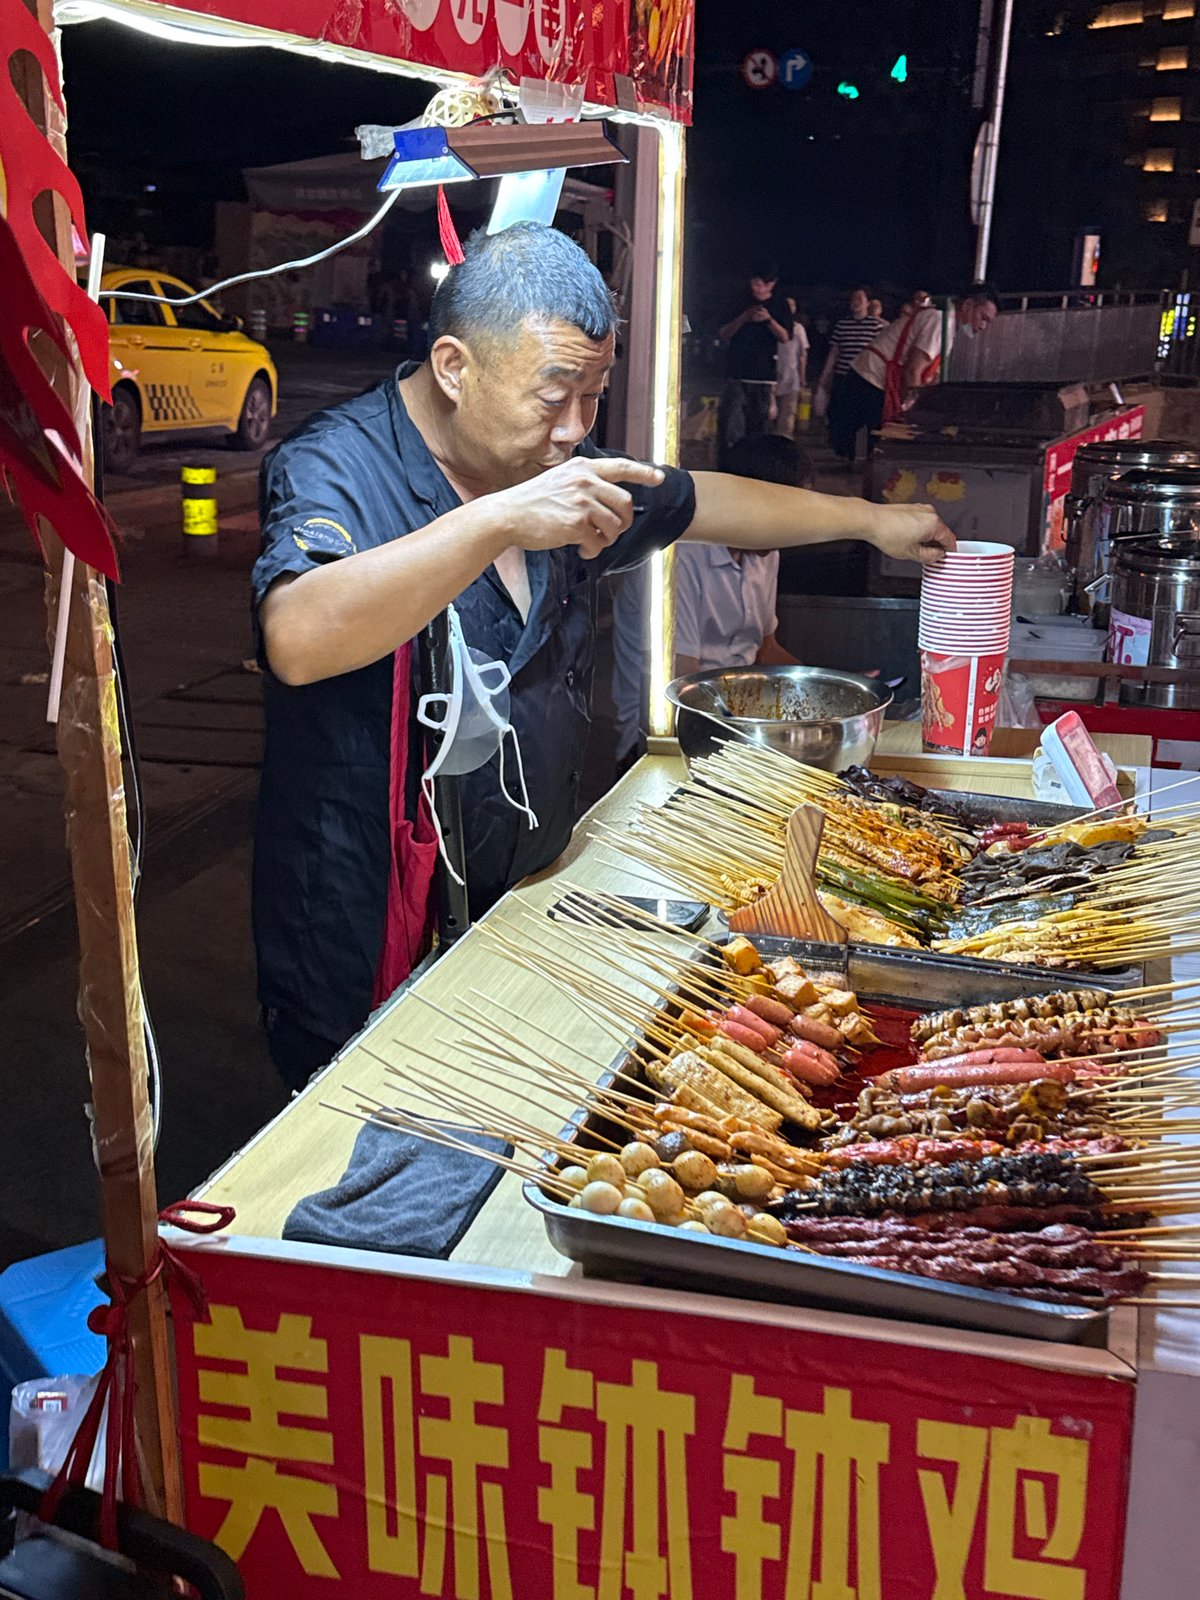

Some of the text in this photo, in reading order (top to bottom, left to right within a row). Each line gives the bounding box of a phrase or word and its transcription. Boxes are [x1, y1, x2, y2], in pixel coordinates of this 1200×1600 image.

[193, 1304, 1089, 1600] 美味钵钵鸡
